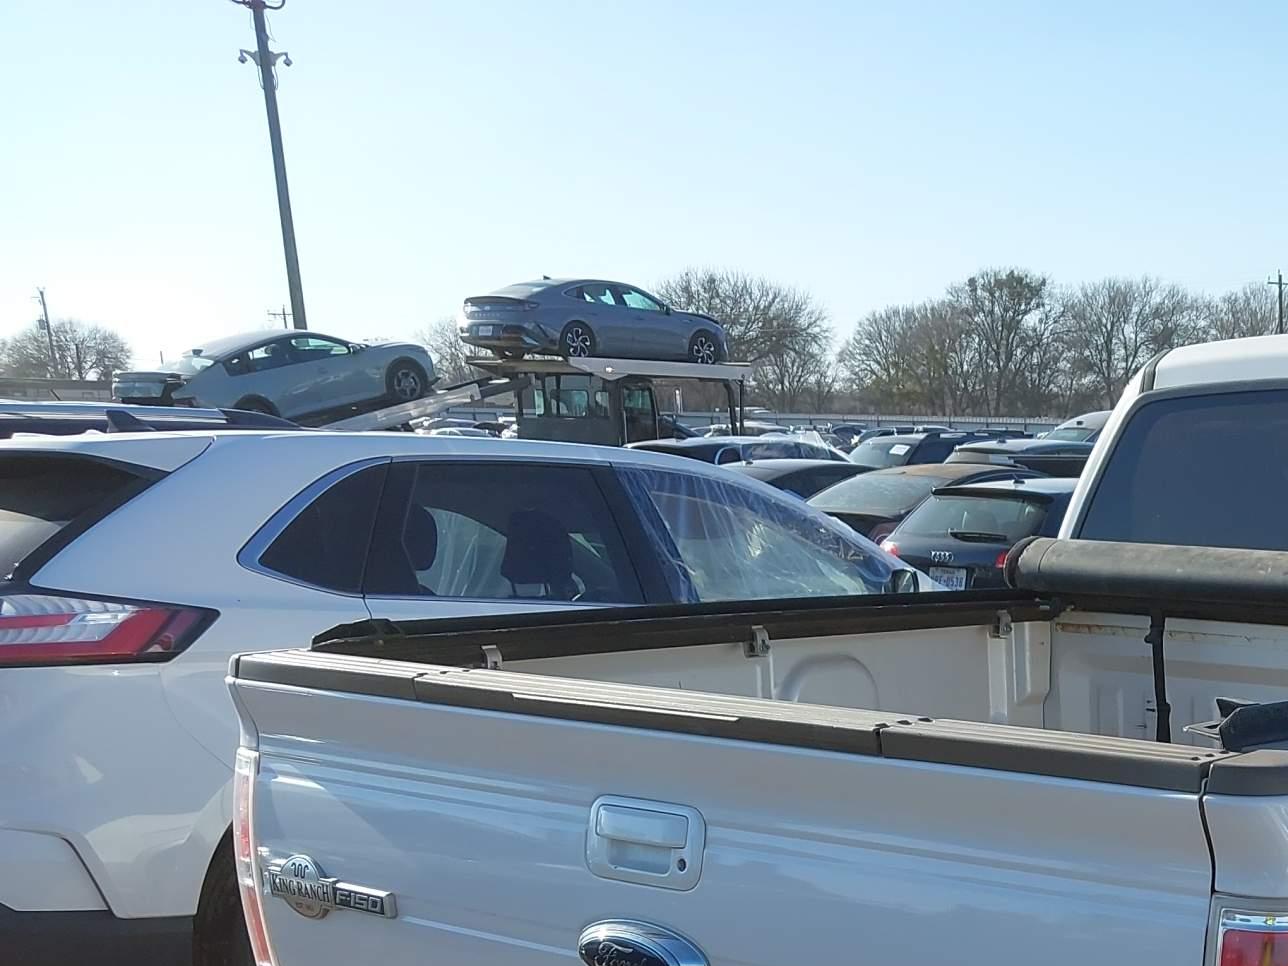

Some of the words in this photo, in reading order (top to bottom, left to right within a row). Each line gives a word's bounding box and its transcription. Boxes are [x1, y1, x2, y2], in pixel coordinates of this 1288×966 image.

[271, 873, 296, 896] KING
[297, 880, 330, 903] RANCH
[336, 890, 382, 912] F-150
